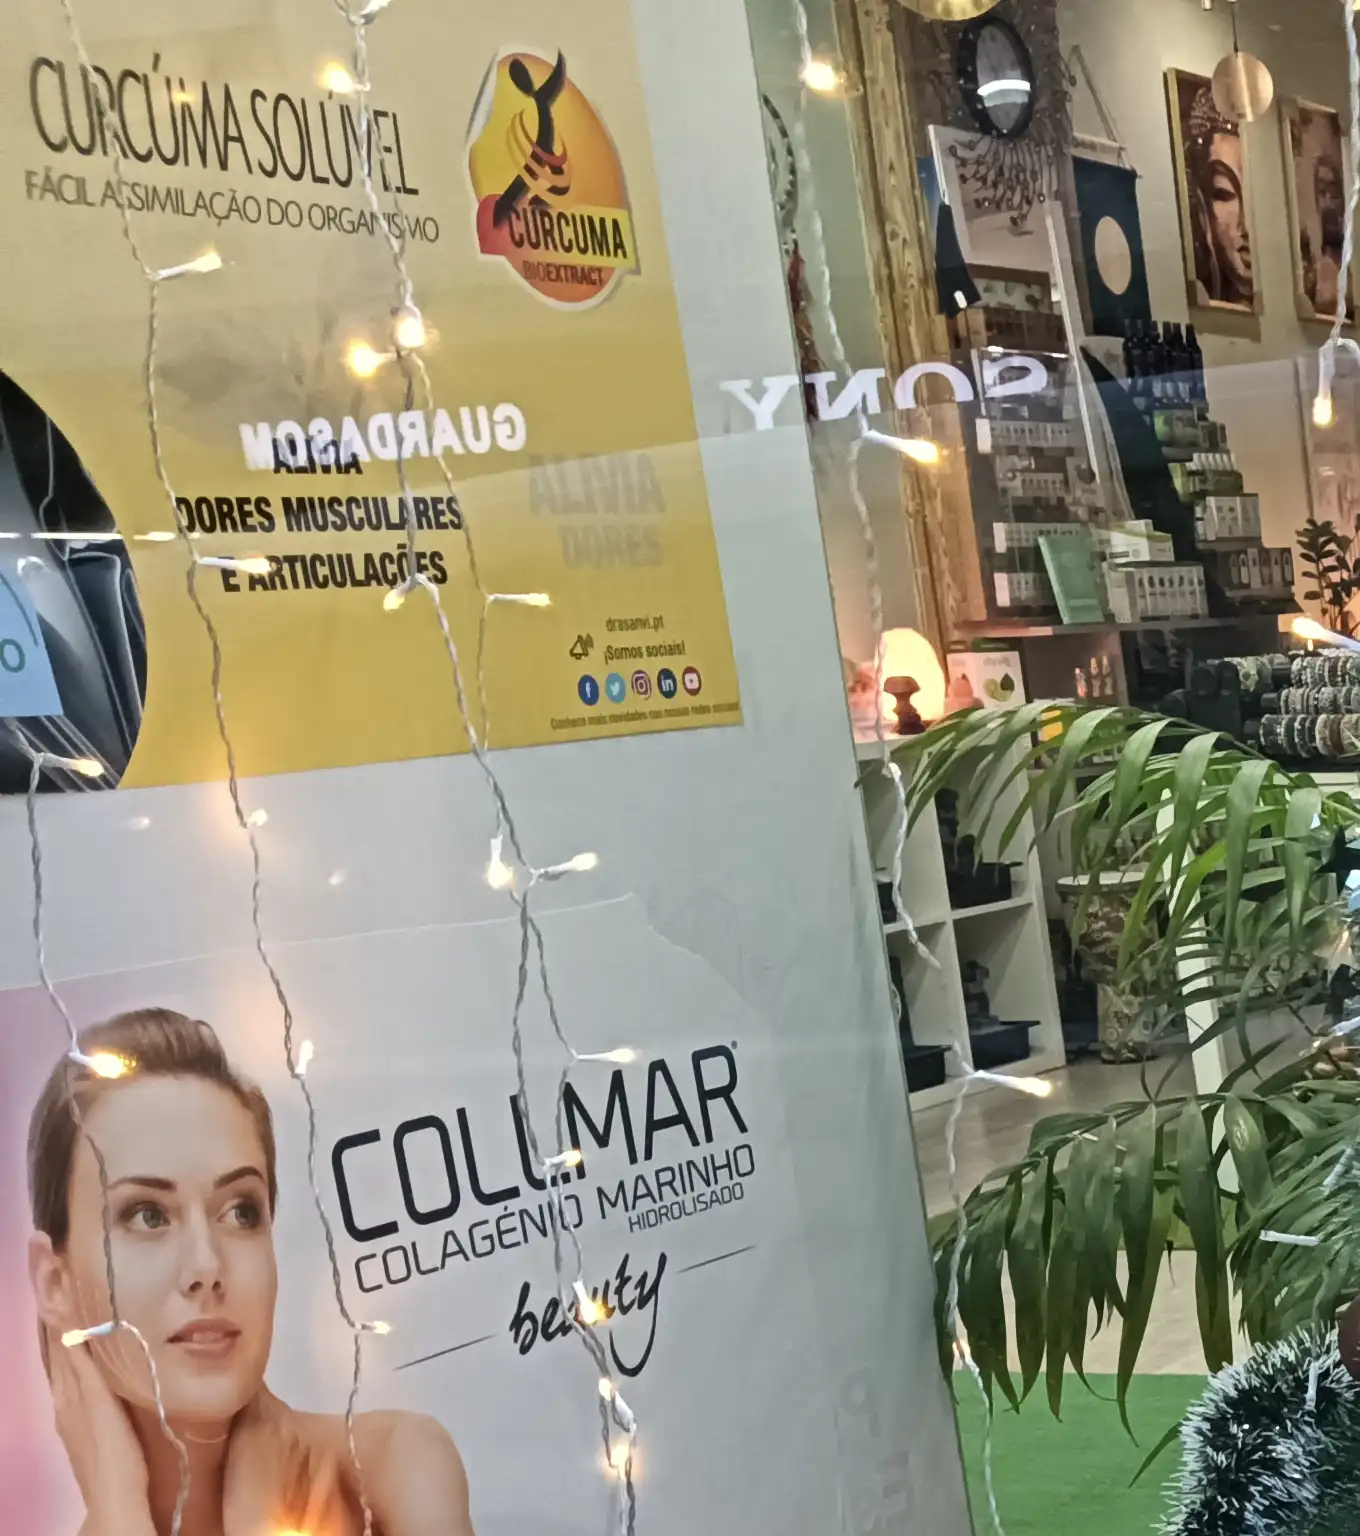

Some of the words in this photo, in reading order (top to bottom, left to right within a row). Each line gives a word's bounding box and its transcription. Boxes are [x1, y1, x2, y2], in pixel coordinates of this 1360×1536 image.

[30, 52, 253, 175] CURCÚMA
[249, 87, 419, 196] SOLÚVEL
[25, 165, 96, 208] FÁCIL
[267, 197, 304, 228] DO
[508, 207, 629, 260] CURCUMA
[522, 259, 603, 286] BIOEXTRACT
[175, 495, 277, 535] DORES
[286, 495, 464, 532] MUSCULARES
[221, 556, 242, 592] E
[248, 543, 449, 592] ARTICULAÇÕES
[605, 614, 665, 632] drasanvi.pt
[331, 1044, 748, 1243] COLLMAR
[354, 1193, 584, 1294] COLAGÉNIO
[596, 1143, 755, 1220] MARINHO
[628, 1182, 744, 1234] HIDROLISADO
